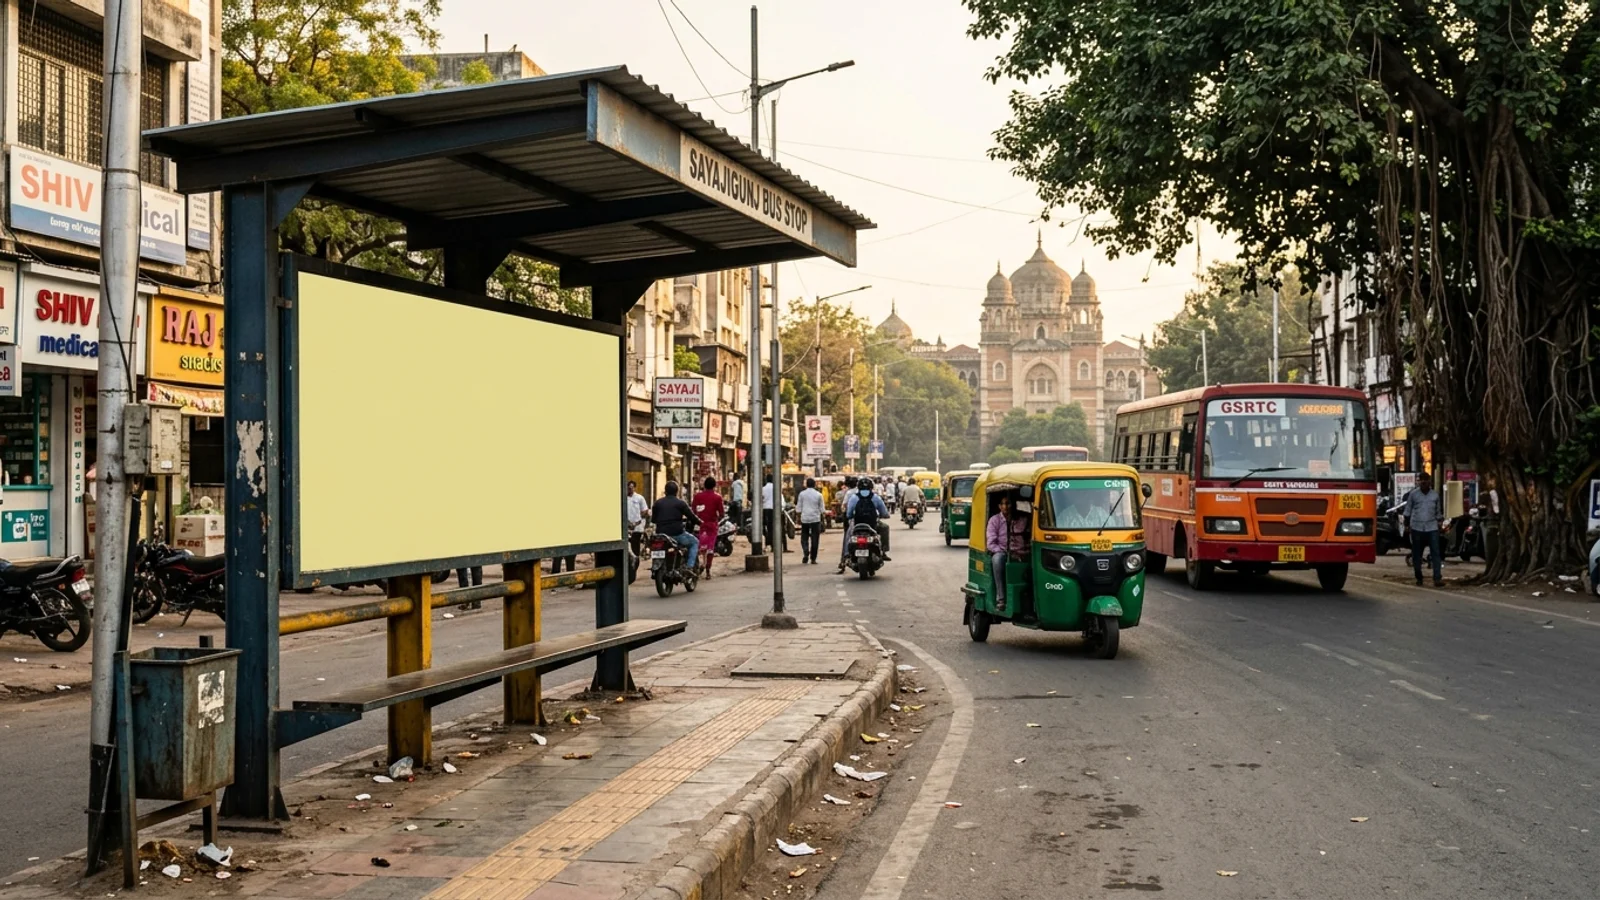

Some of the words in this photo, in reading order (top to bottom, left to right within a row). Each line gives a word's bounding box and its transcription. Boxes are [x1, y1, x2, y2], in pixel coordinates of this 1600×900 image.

[21, 164, 94, 212] SHIV
[689, 148, 760, 211] SAYAJIGUNJ
[763, 187, 782, 222] BUS
[784, 201, 808, 234] STOP
[36, 289, 95, 326] SHIV
[161, 305, 217, 347] RAJ
[38, 333, 99, 358] medica
[1221, 401, 1277, 414] GSRTC
